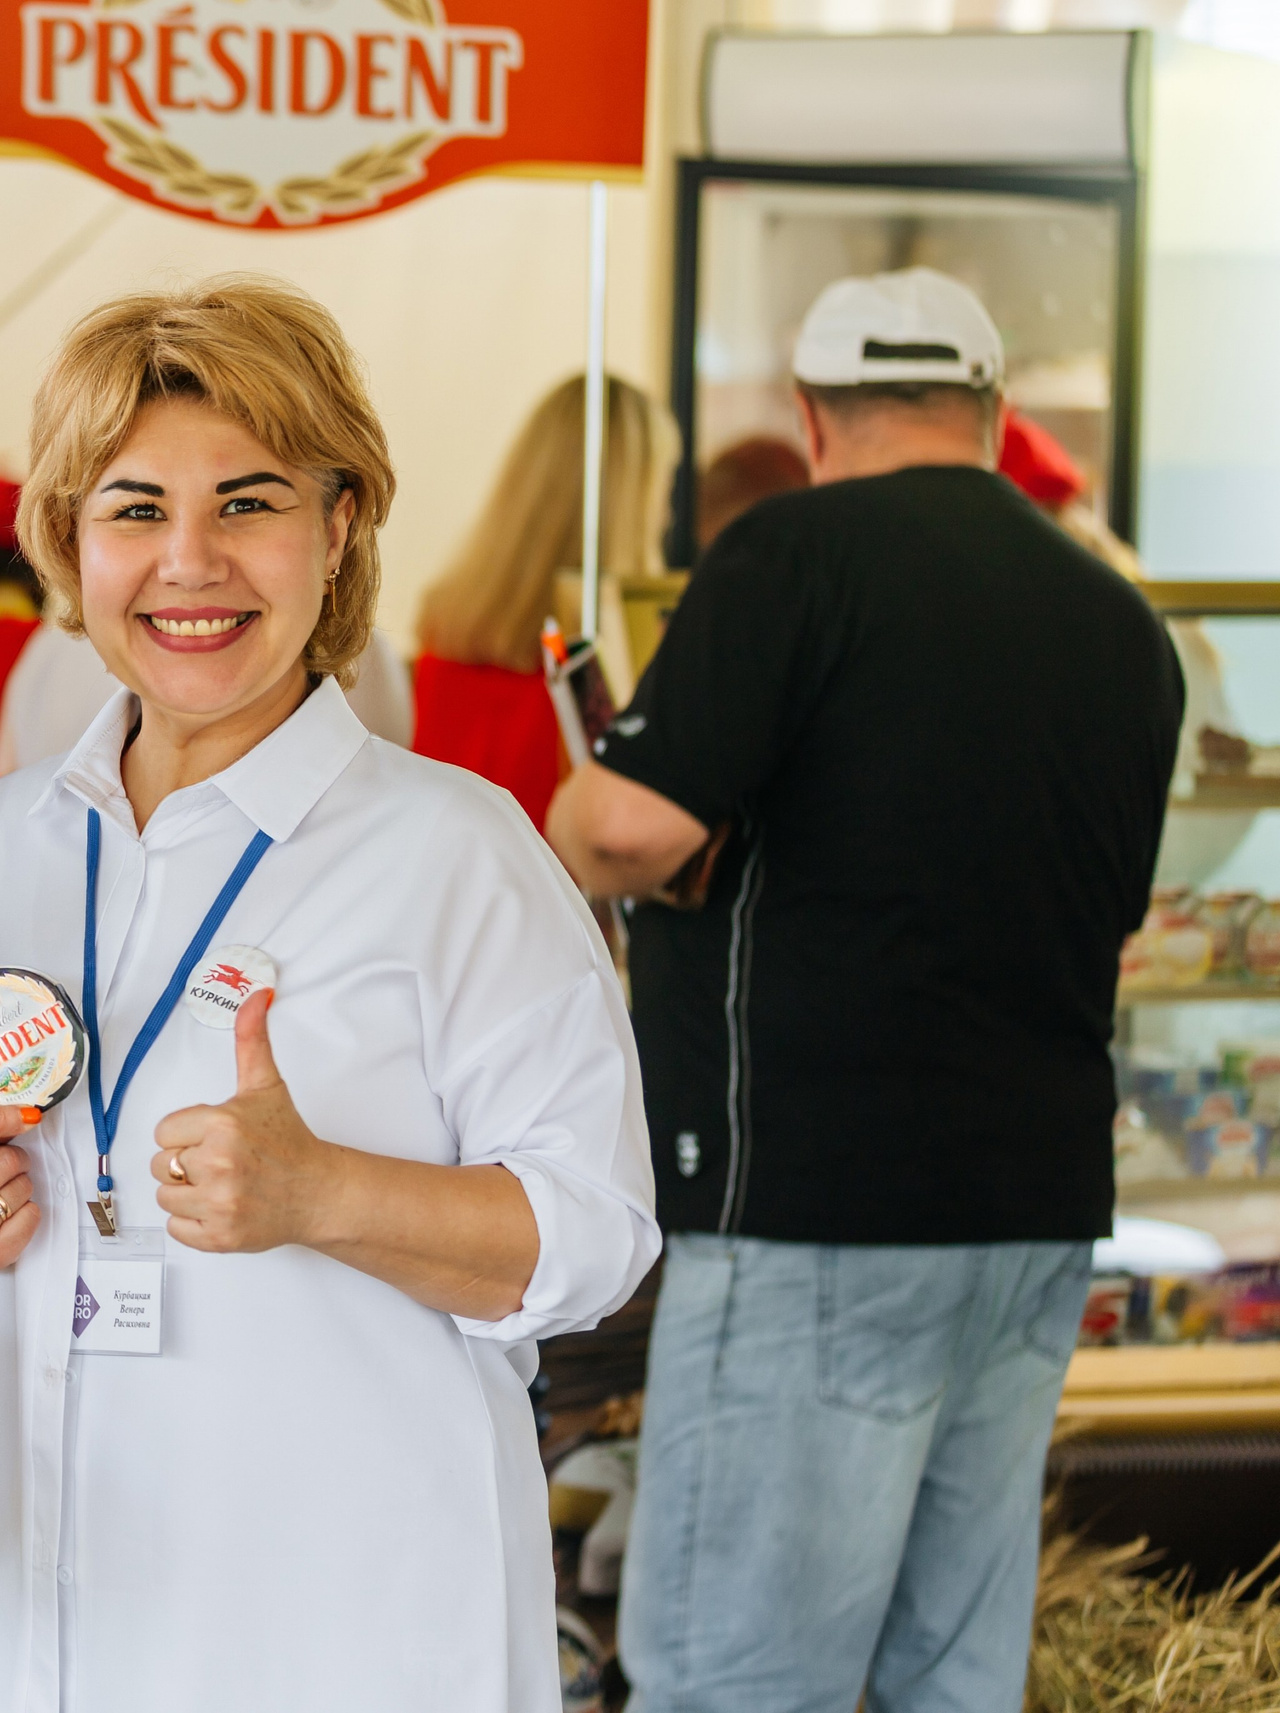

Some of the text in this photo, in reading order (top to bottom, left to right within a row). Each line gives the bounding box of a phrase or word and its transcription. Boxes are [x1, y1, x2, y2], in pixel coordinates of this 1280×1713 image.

[37, 3, 511, 131] PRÉSIDENT
[189, 986, 240, 1012] КУРКИН
[74, 1294, 91, 1307] OR
[74, 1307, 91, 1320] RO
